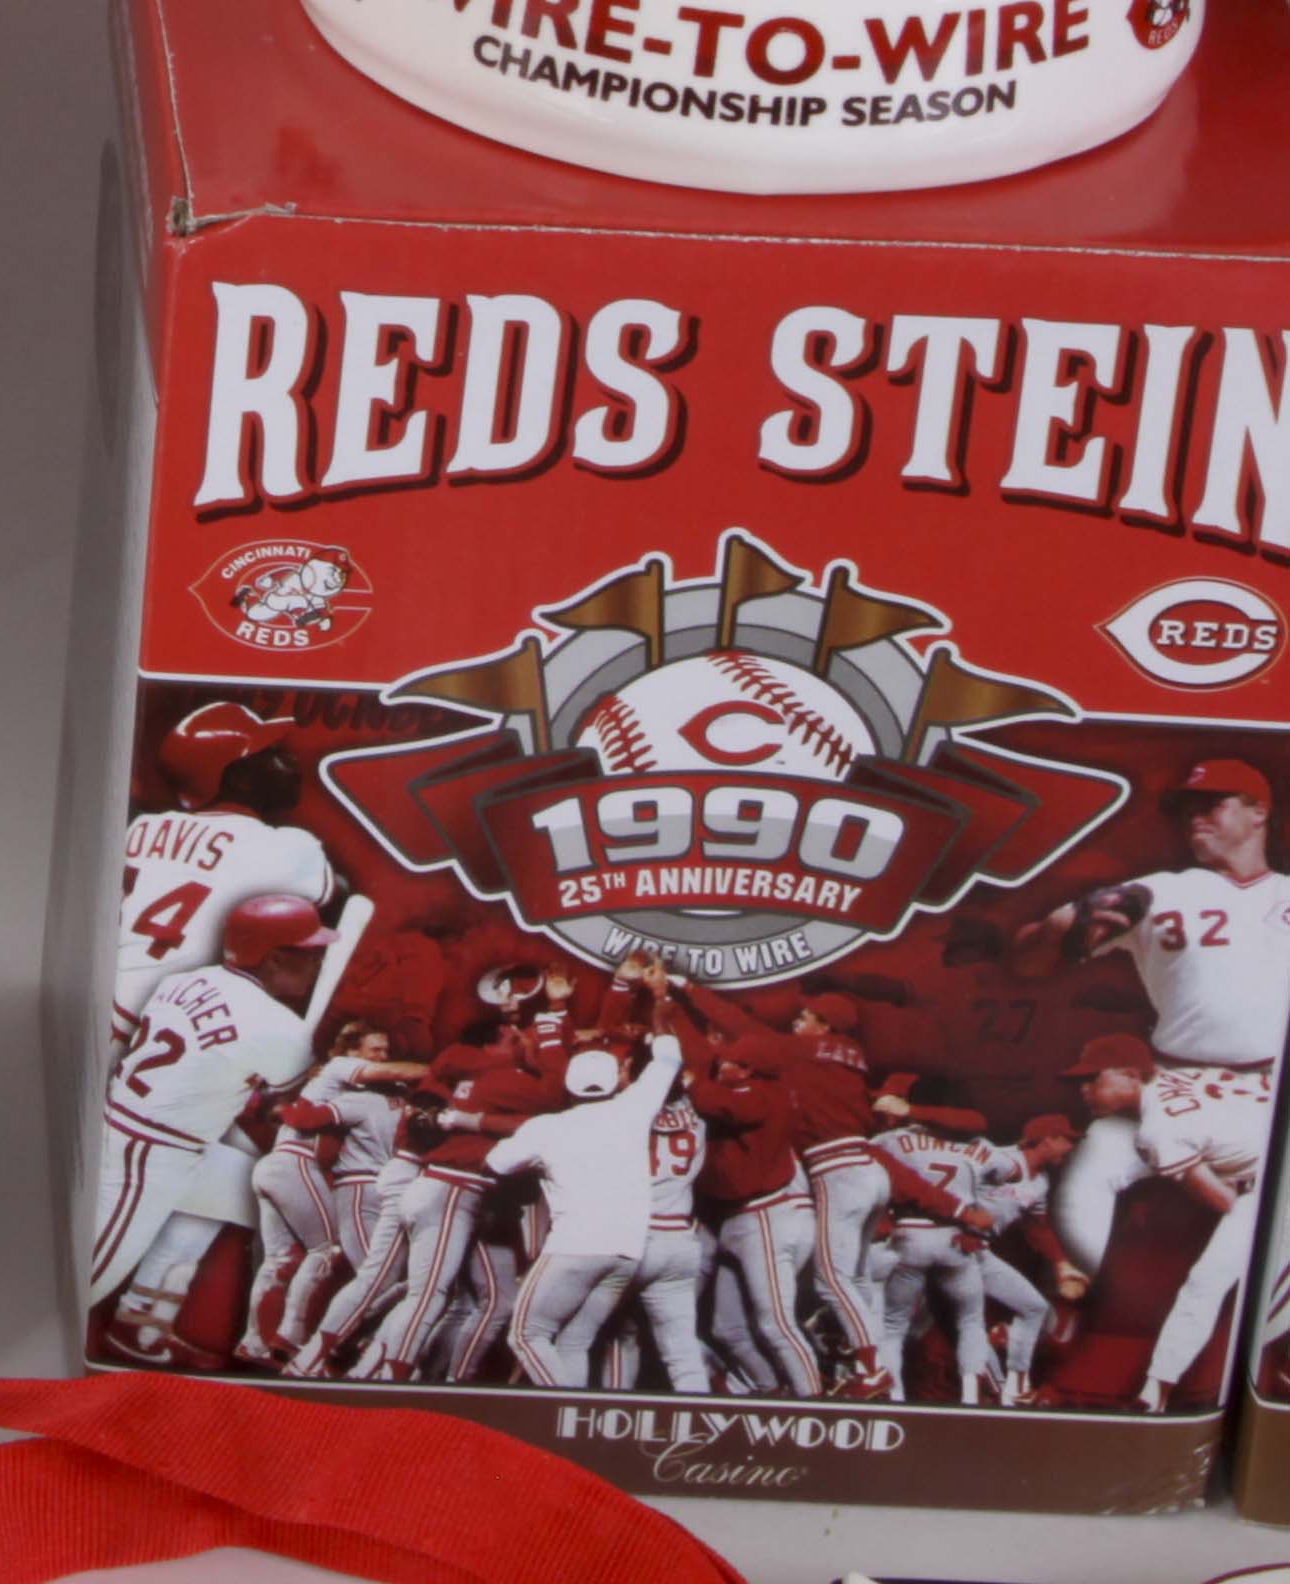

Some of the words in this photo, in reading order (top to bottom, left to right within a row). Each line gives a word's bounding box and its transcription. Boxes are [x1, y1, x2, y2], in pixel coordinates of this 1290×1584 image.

[472, 32, 828, 127] CHAMPIONSHIP
[840, 78, 1019, 127] SEASON
[193, 280, 691, 522] REDS
[221, 545, 312, 581] CINCINNATI
[235, 620, 311, 648] REDS
[1156, 618, 1279, 652] REDS
[125, 818, 235, 872] DAVIS
[530, 785, 906, 881] 1990
[558, 871, 626, 908] 25TH
[635, 866, 863, 913] ANNIVERSARY
[687, 946, 724, 975] TO
[734, 930, 813, 975] WIRE
[1152, 908, 1231, 953] 32
[897, 1133, 993, 1165] DUNCAN
[928, 1163, 959, 1189] 7
[556, 1405, 906, 1452] HOLLYWOOD
[641, 1432, 799, 1487] Casino
